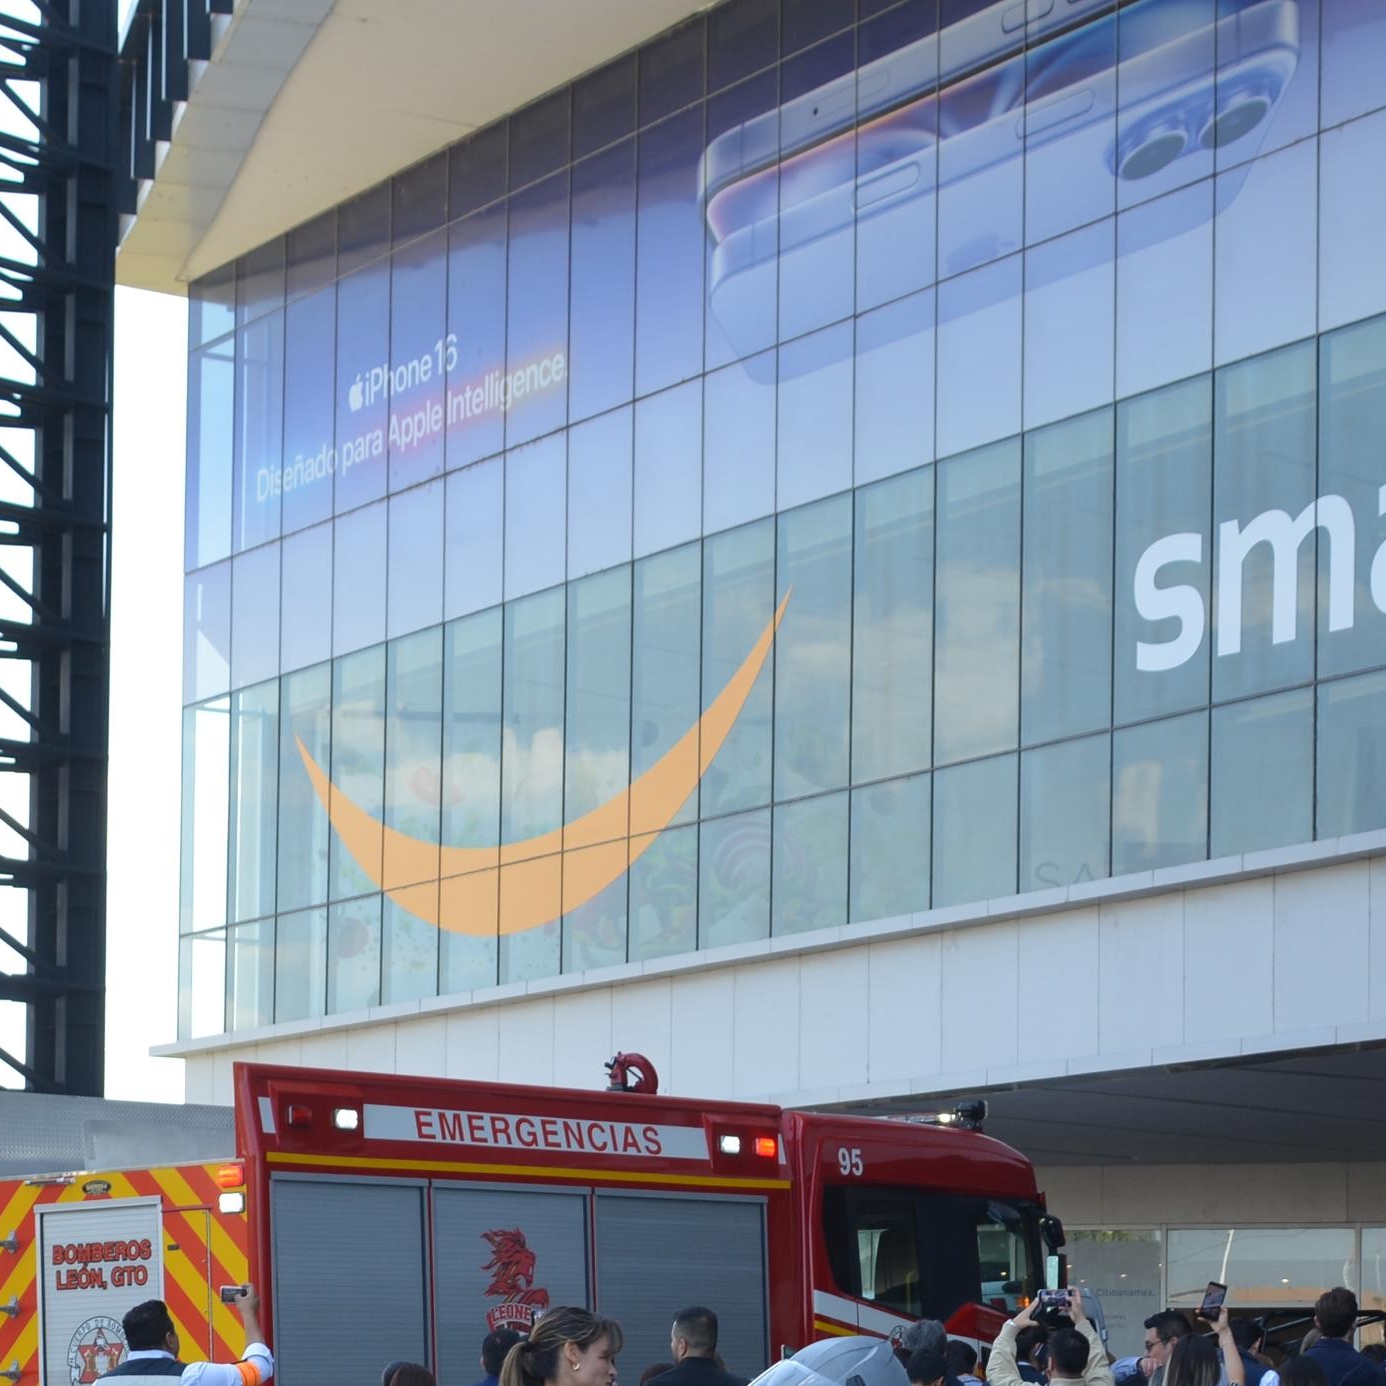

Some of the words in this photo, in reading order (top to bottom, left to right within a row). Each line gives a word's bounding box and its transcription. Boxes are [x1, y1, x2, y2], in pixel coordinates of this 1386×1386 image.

[365, 355, 432, 406] iPhone
[435, 333, 458, 375] 16
[256, 444, 338, 502] Diseñado
[342, 426, 383, 475] para
[388, 404, 442, 452] Apple
[414, 1110, 662, 1155] EMERGENCIAS
[837, 1147, 864, 1177] 95
[52, 1238, 152, 1265] BOMBEROS
[111, 1264, 148, 1287] GTO
[490, 1303, 532, 1322] LEONE
